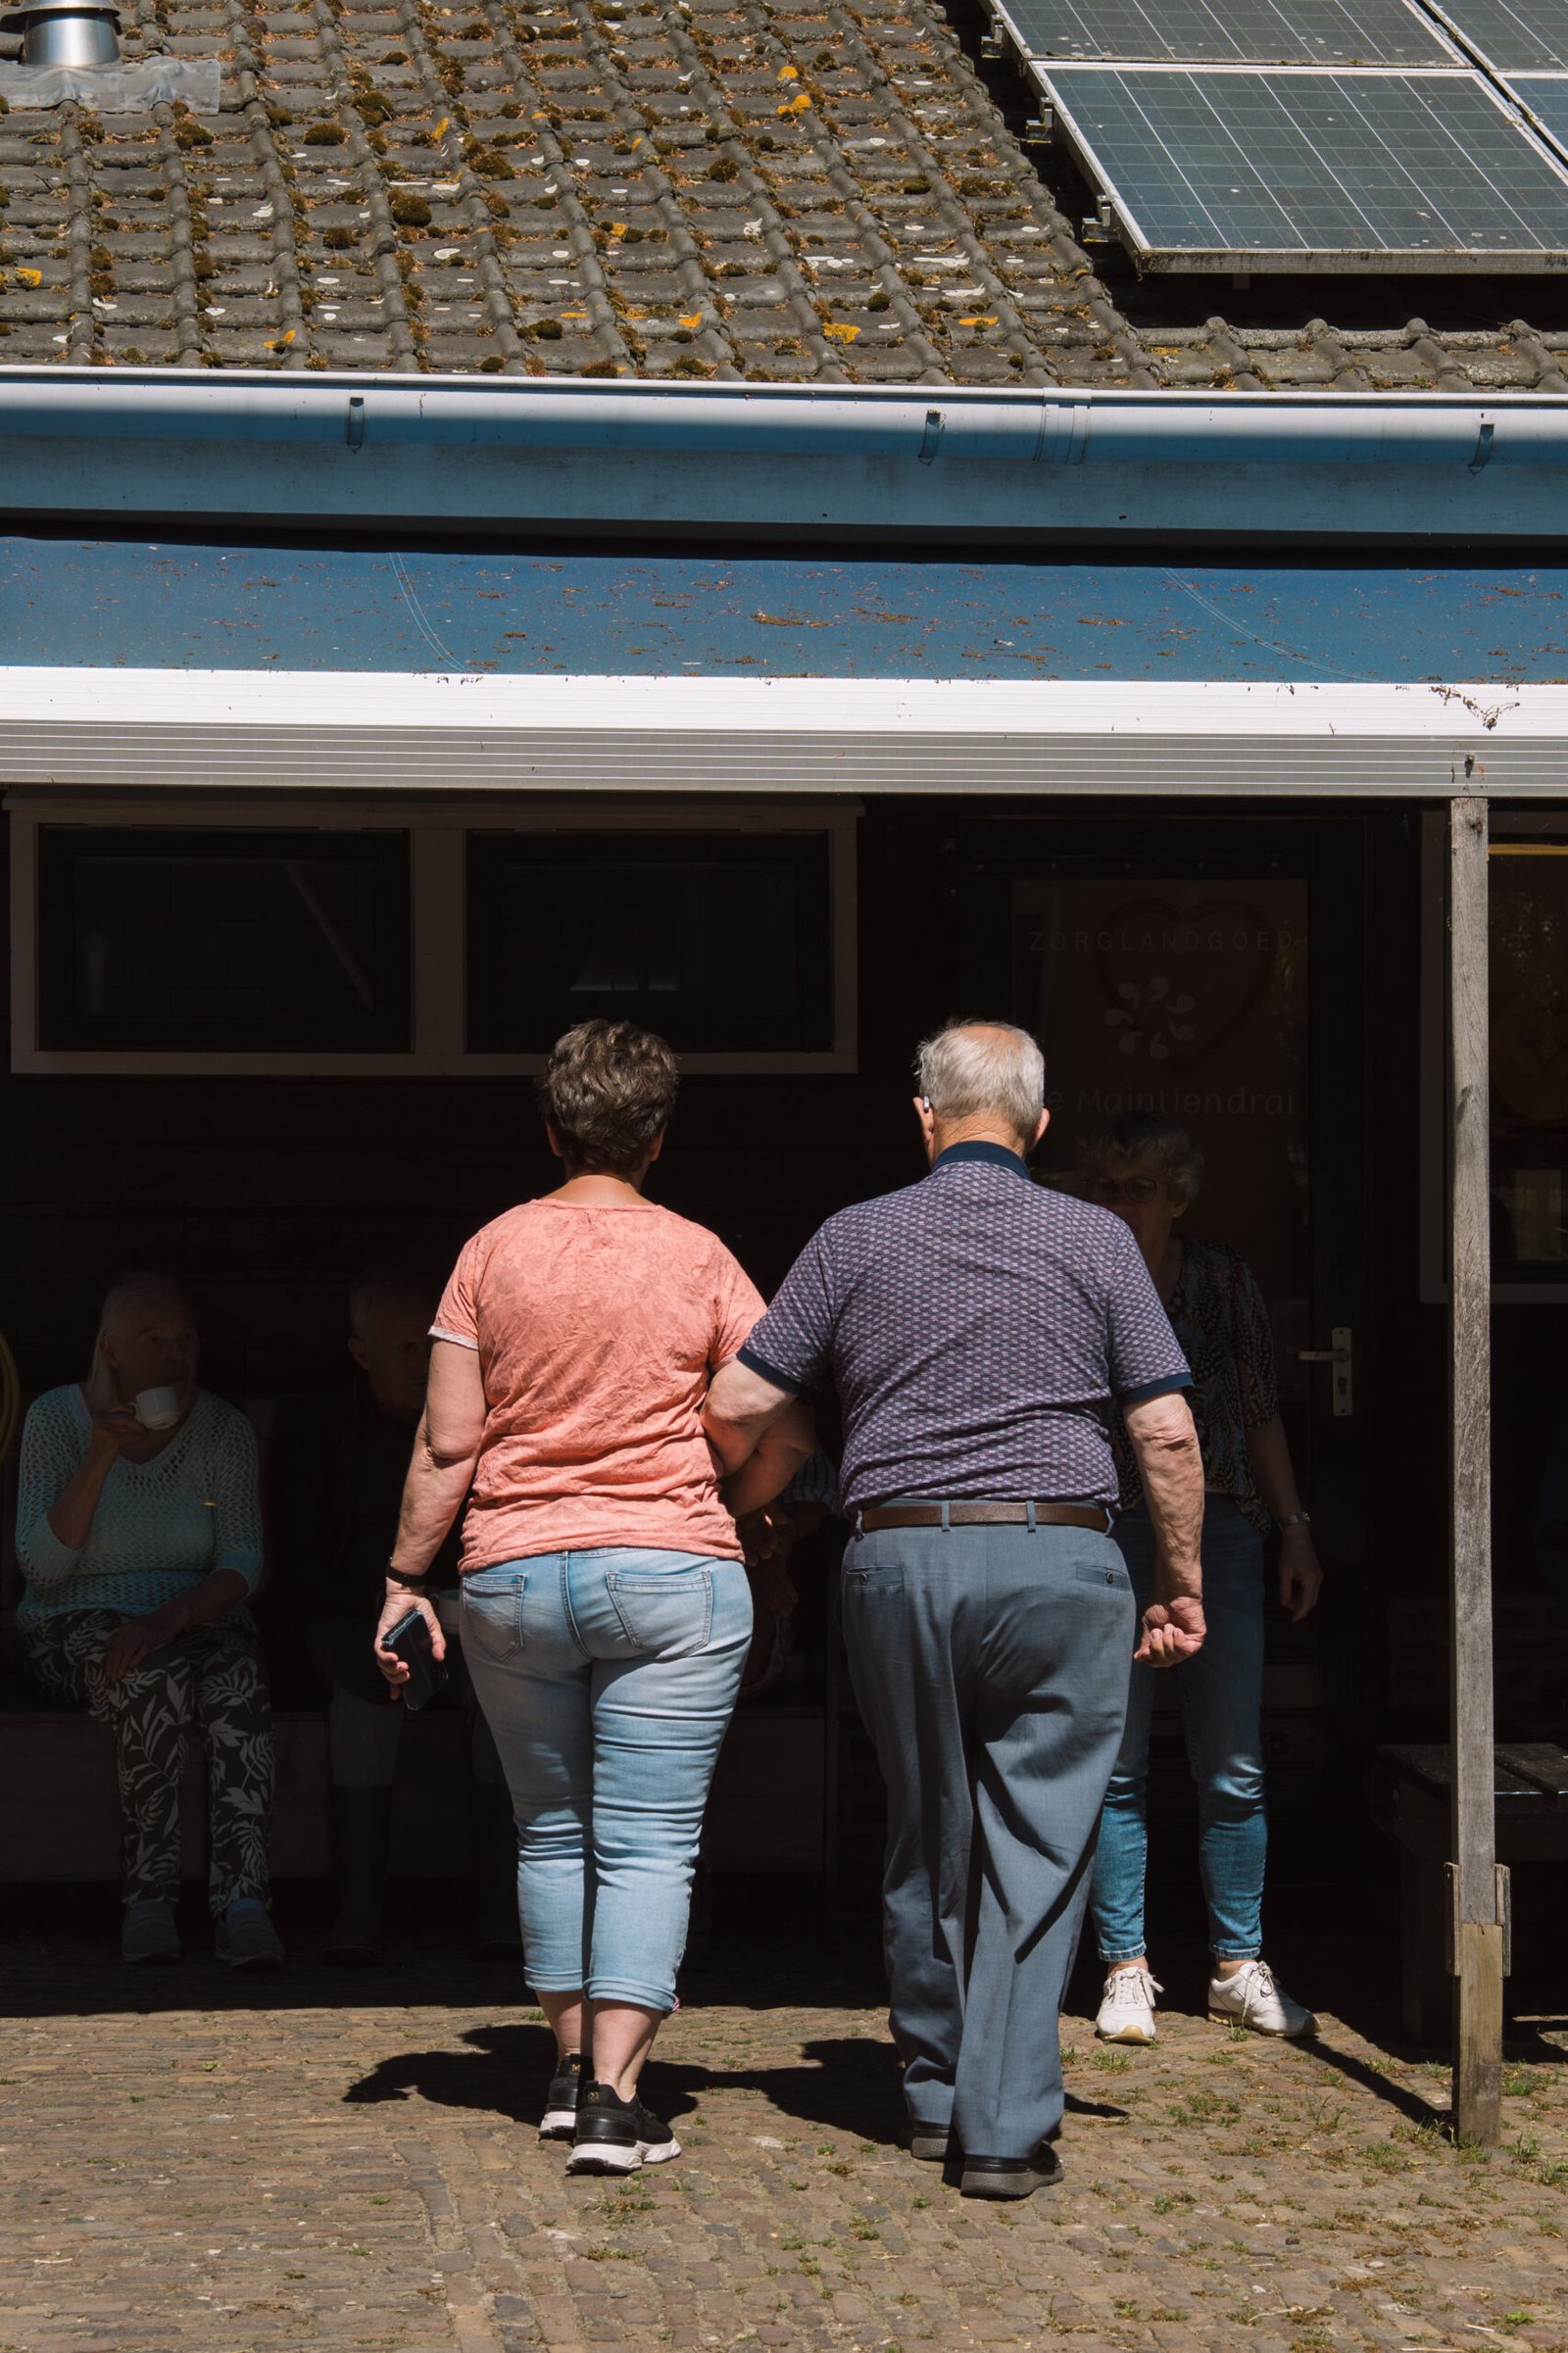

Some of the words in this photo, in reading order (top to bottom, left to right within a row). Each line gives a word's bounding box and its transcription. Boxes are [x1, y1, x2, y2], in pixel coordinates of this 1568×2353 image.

[1029, 931, 1293, 951] ZORGLANDGOED
[1047, 1090, 1065, 1112] e
[1077, 1085, 1294, 1116] Maintiendrai
